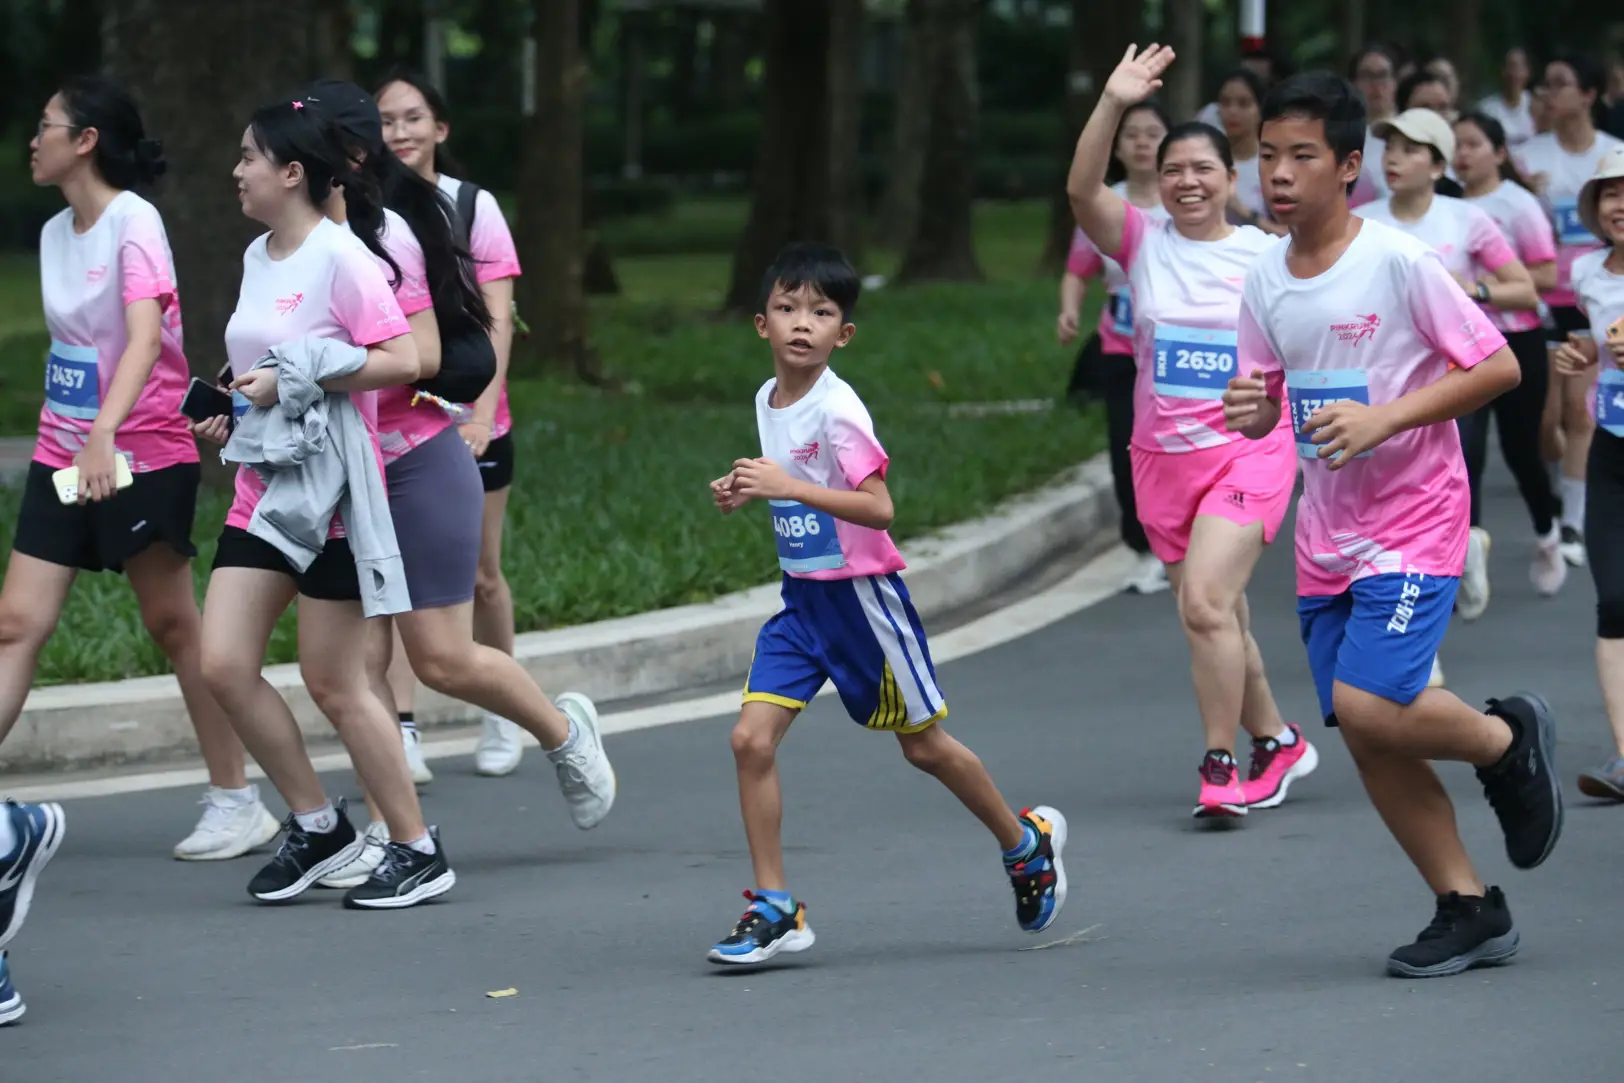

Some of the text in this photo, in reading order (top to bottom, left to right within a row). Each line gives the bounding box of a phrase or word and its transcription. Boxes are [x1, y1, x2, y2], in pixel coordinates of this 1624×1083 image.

[1176, 350, 1232, 372] 2630
[52, 364, 85, 388] 2437
[1301, 397, 1351, 422] 33
[774, 513, 820, 537] 4086
